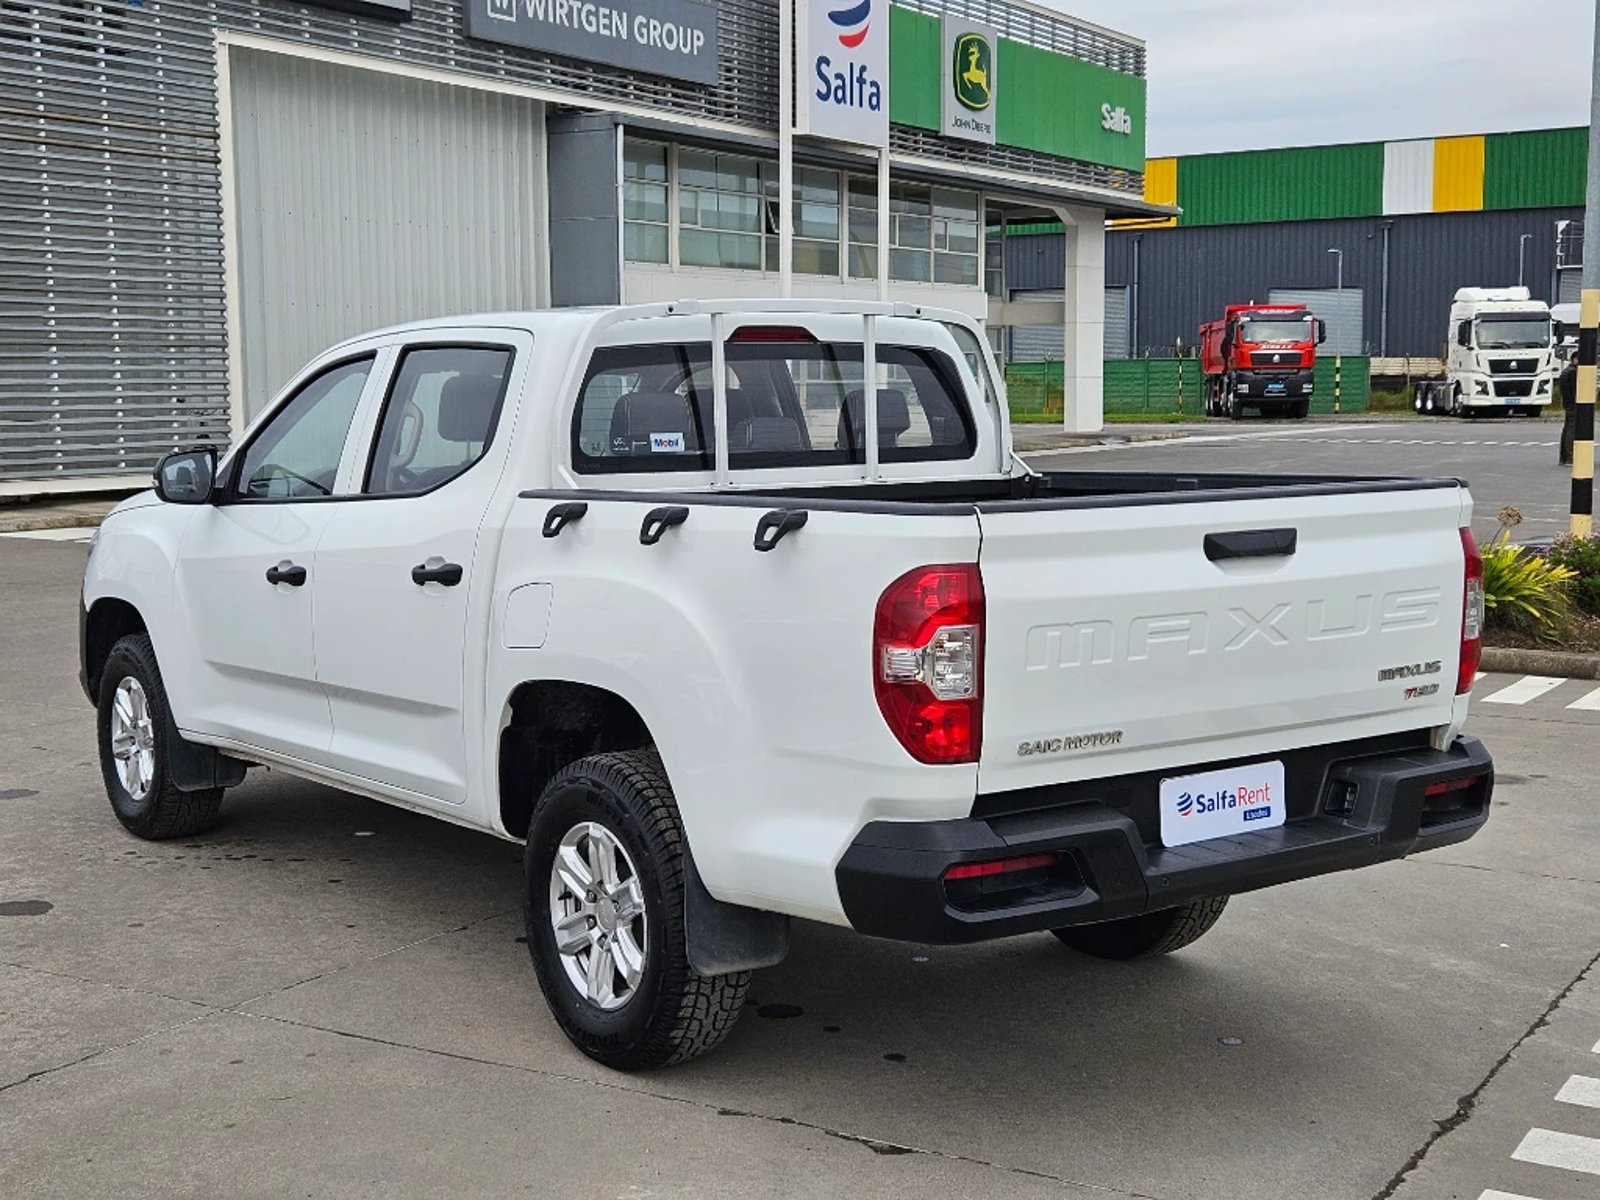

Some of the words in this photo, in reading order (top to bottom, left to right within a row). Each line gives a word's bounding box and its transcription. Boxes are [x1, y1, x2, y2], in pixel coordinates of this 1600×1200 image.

[525, 0, 628, 40] WIRTGEN
[633, 14, 705, 56] GROUP
[815, 55, 881, 112] Salfa
[952, 114, 971, 130] JOHN
[1101, 103, 1131, 134] Salfa
[653, 438, 679, 448] Mobil
[1026, 586, 1442, 671] MAXUS
[1377, 660, 1442, 682] MAXUS
[1016, 738, 1062, 757] SAIC
[1063, 730, 1124, 751] MOTOR
[1195, 782, 1271, 814] SalfaRent
